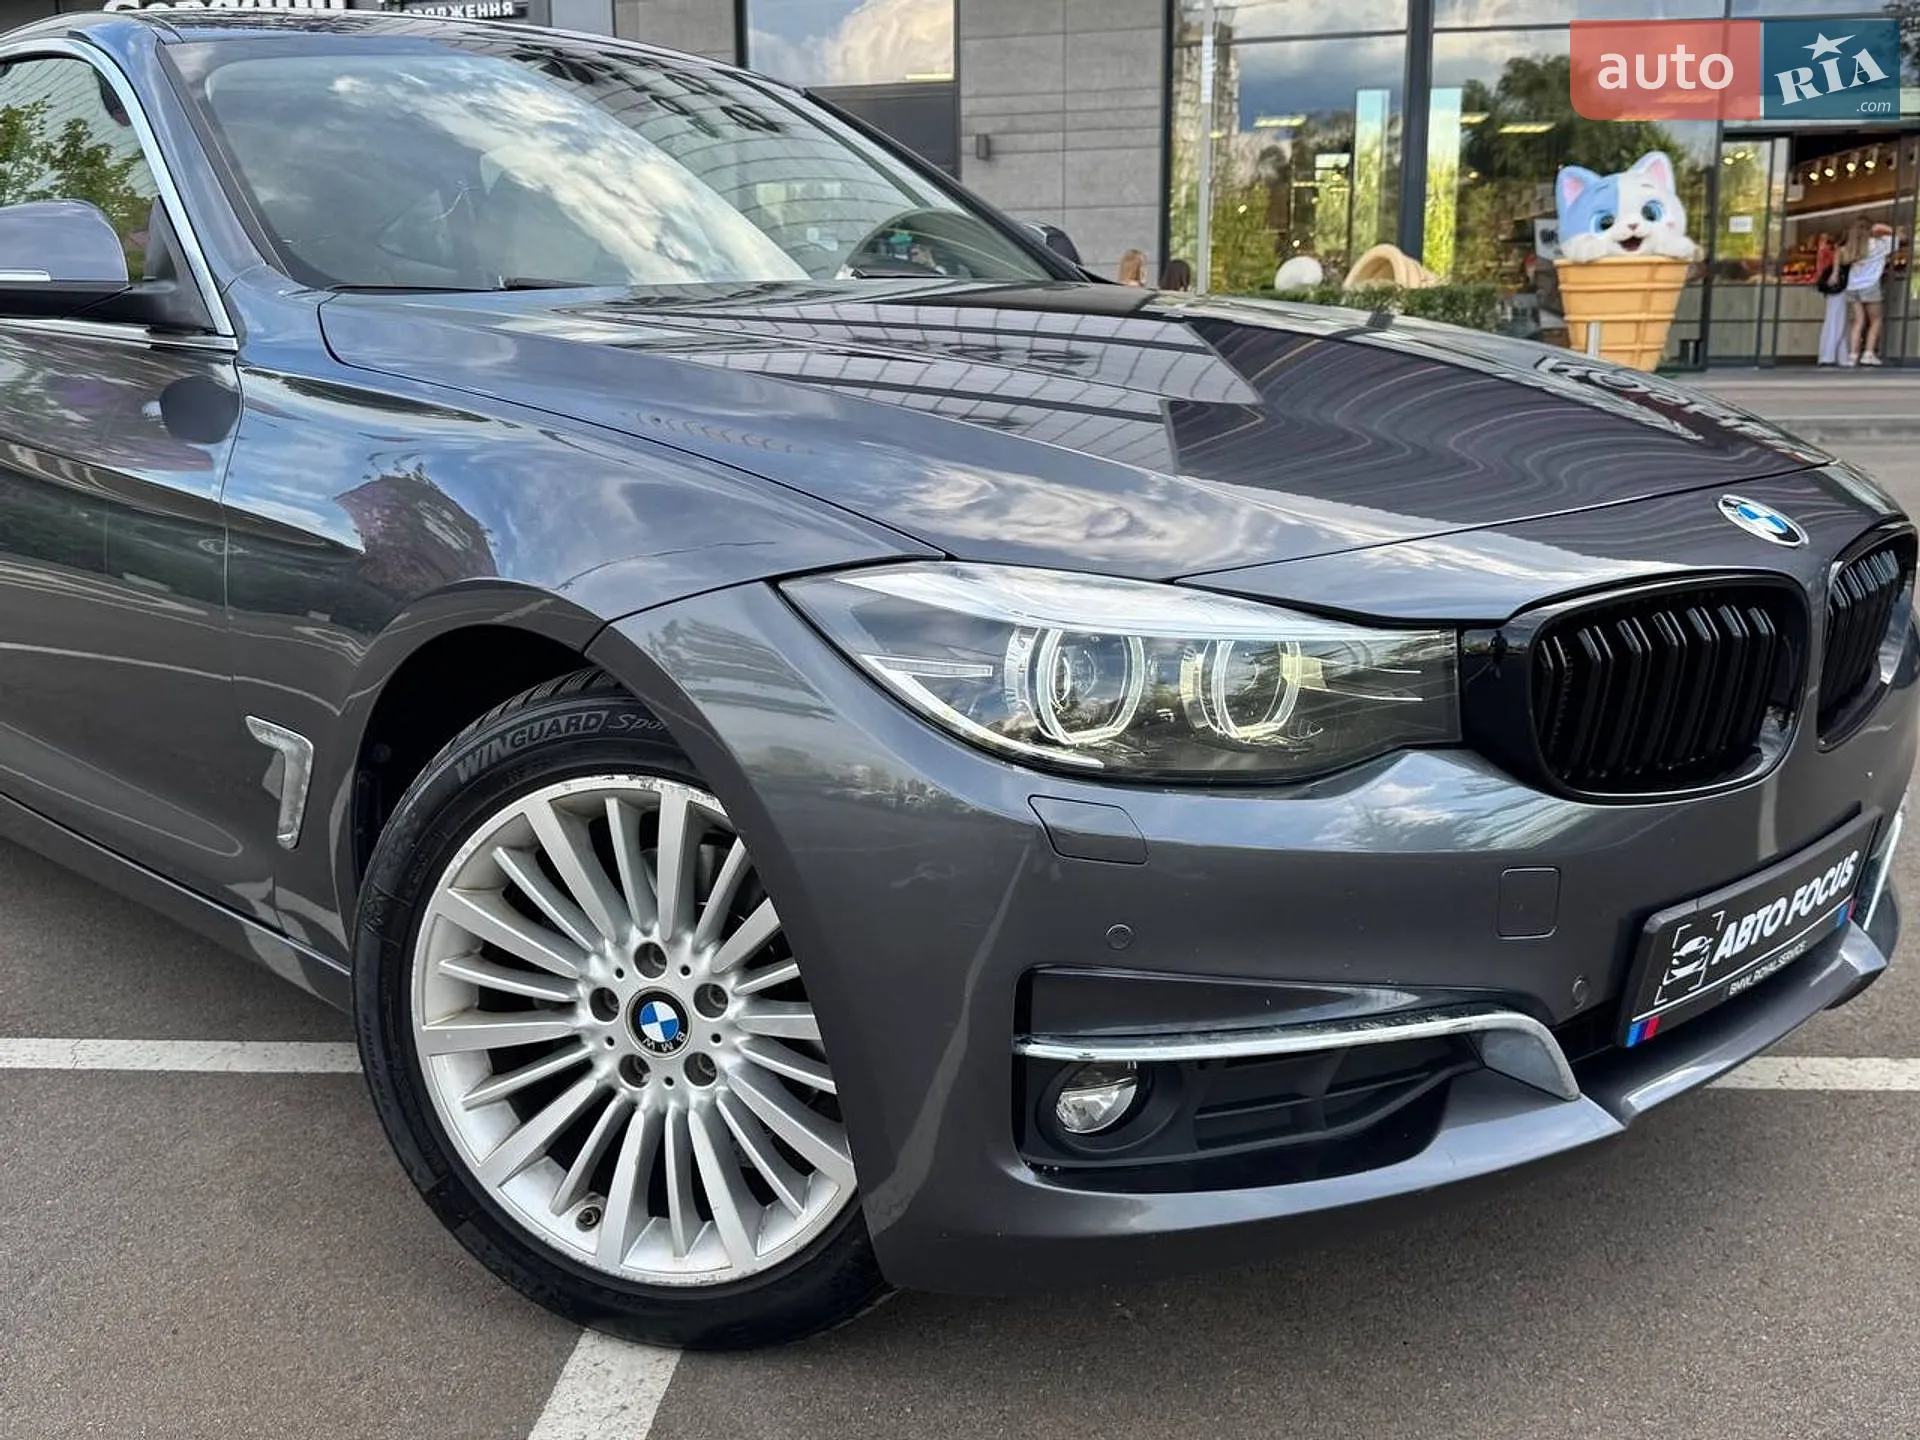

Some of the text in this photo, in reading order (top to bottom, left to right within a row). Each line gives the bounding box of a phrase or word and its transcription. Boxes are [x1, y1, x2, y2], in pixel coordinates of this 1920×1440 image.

[455, 711, 607, 784] WINGUARD
[1711, 850, 1859, 965] АВТО FOCUS
[643, 1031, 686, 1051] BMW
